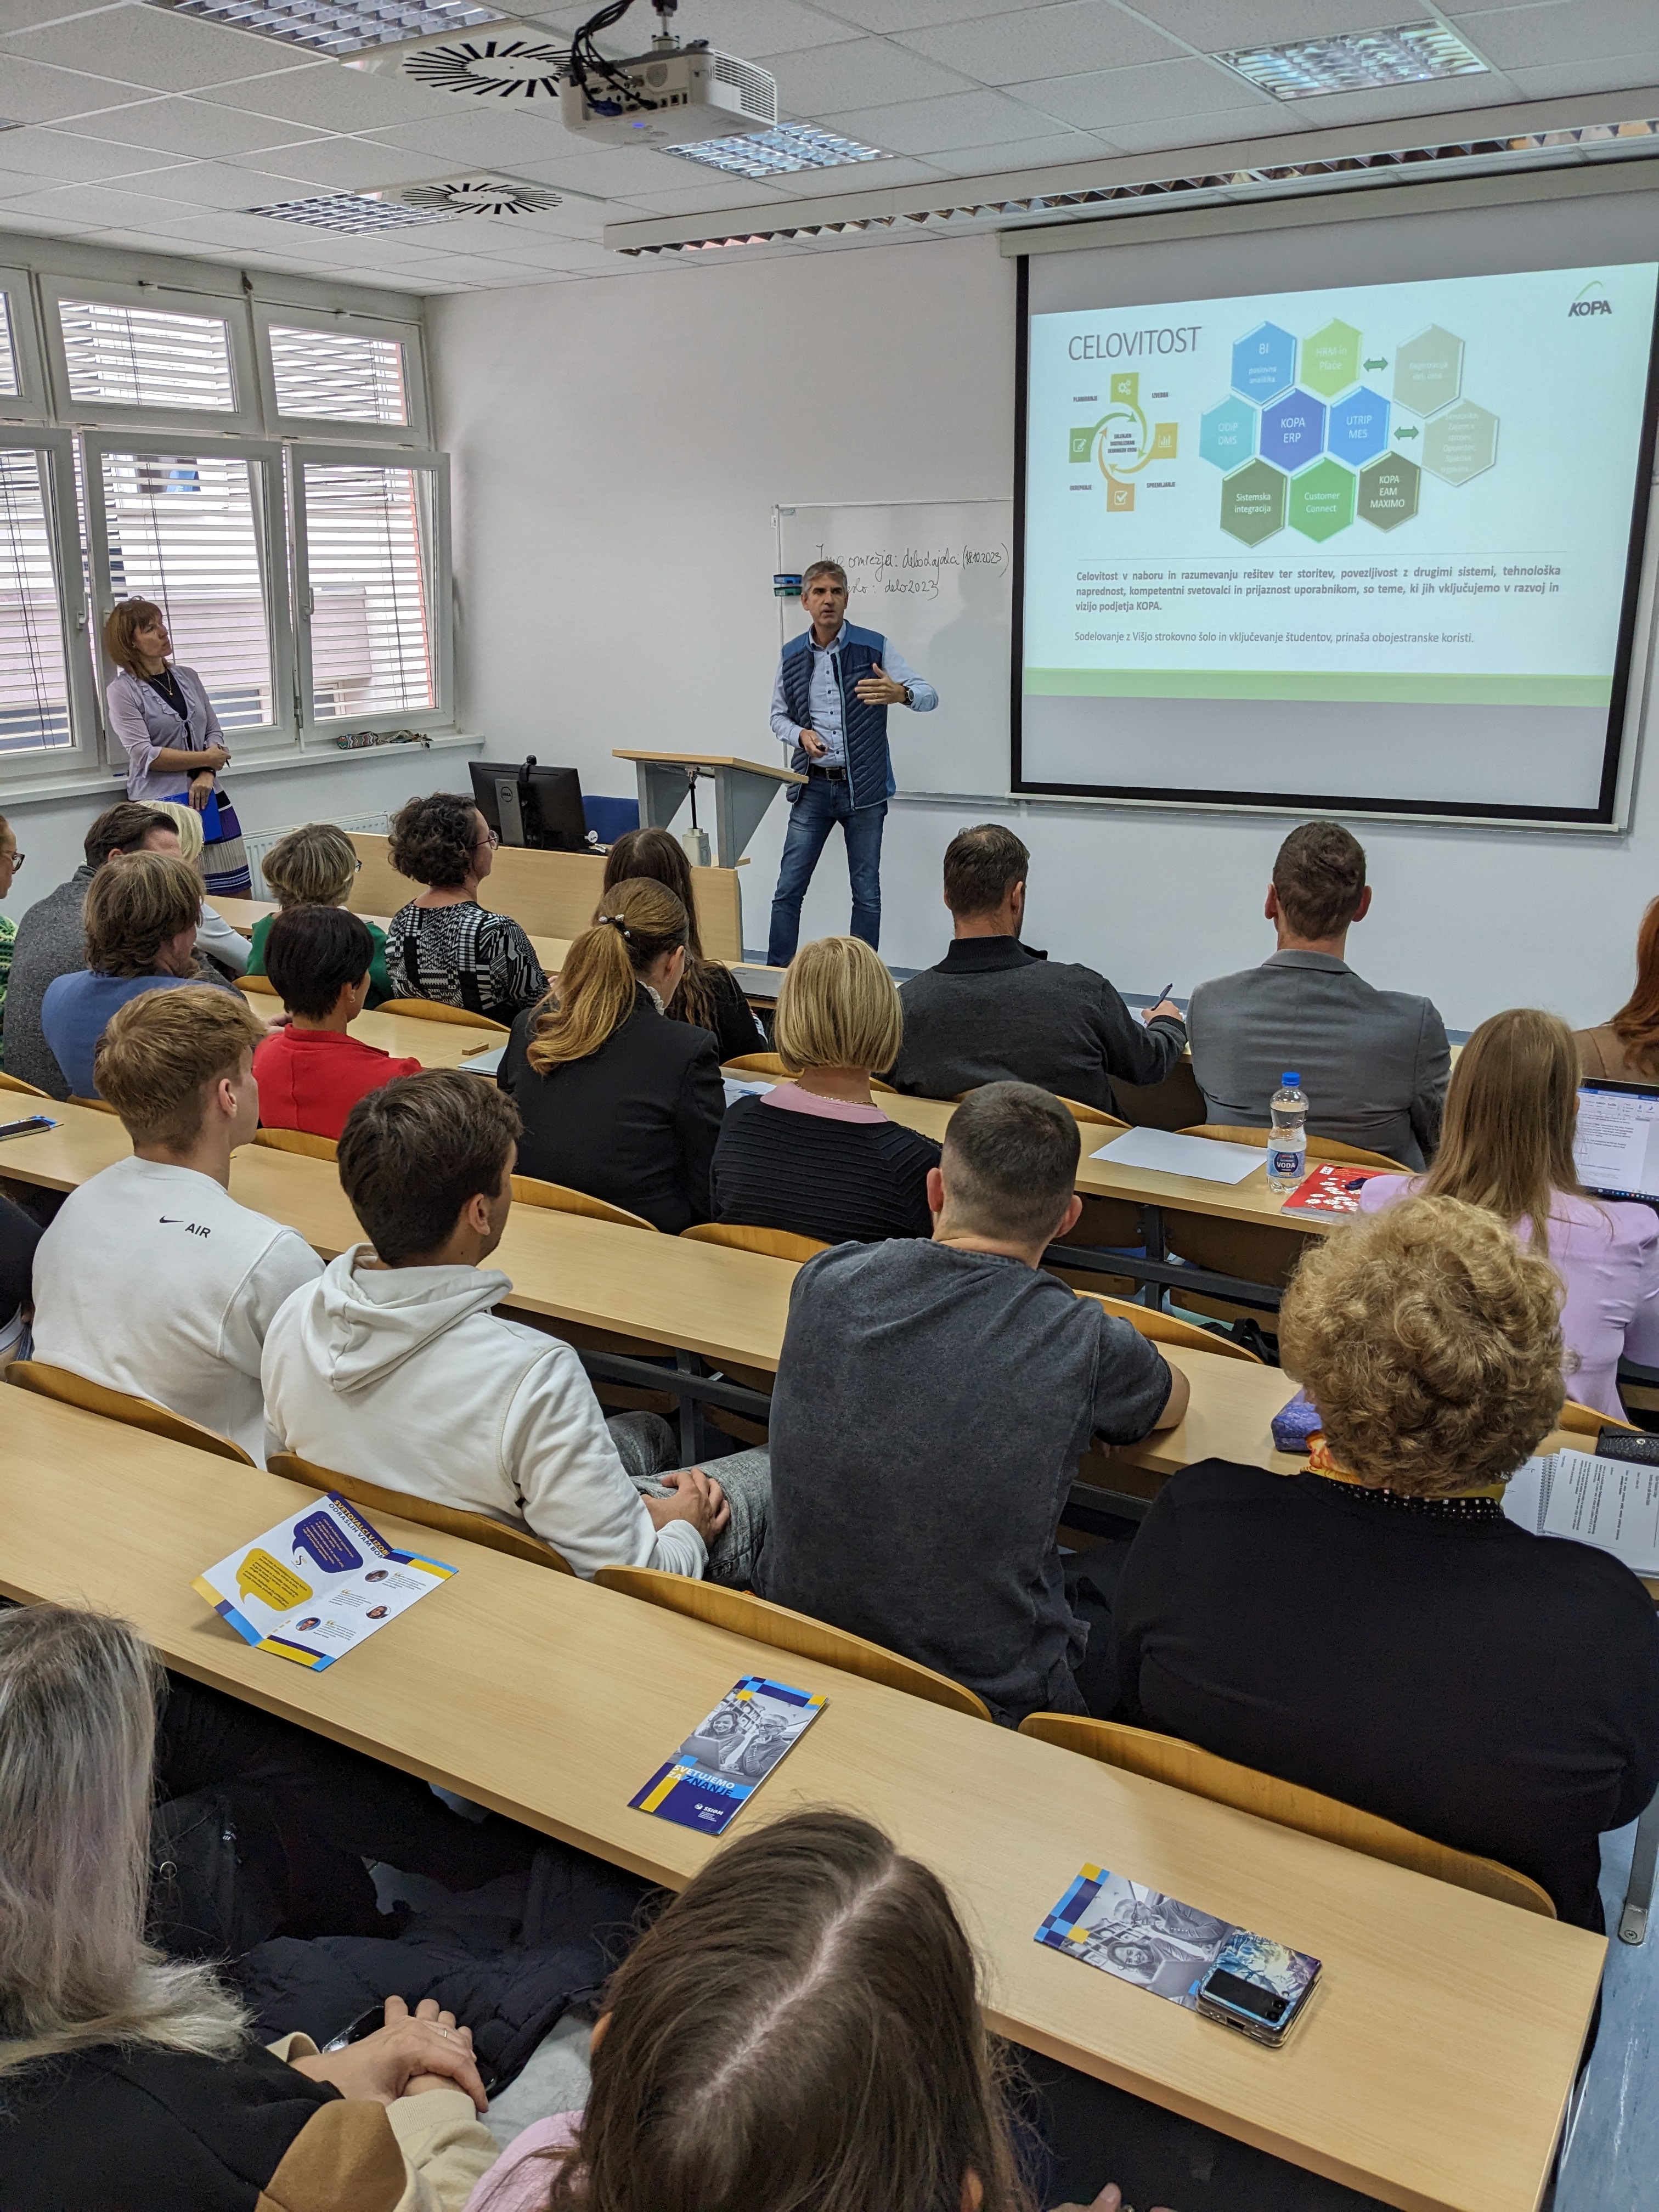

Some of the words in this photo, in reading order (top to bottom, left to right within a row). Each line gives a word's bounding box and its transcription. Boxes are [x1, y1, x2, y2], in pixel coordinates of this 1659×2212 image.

[1568, 300, 1612, 318] KOPA
[1068, 326, 1201, 361] CELOVITOST
[1259, 343, 1269, 355] BI
[1316, 347, 1337, 358] HRM
[1339, 347, 1347, 356] in
[1280, 417, 1306, 428] KOPA
[1346, 415, 1372, 426] UTRIP
[1283, 432, 1302, 443] ERP
[1348, 428, 1368, 439] MES
[1217, 436, 1238, 445] DMS
[1379, 475, 1400, 484] KOPA
[1305, 492, 1340, 501] Customer
[1379, 487, 1397, 496] EAM
[1235, 493, 1271, 502] Sistemska
[1234, 504, 1272, 515] integracija
[1306, 504, 1338, 514] Connect
[1370, 499, 1405, 509] MAXIMO
[962, 543, 1009, 577] (18.10.2023)
[1076, 571, 1118, 581] Celovitost
[1133, 571, 1163, 580] naboru
[1168, 570, 1176, 579] in
[1181, 569, 1238, 582] razumevanju
[1244, 568, 1274, 579] rešitev
[1279, 569, 1293, 579] ter
[1297, 568, 1336, 579] storitev,
[1341, 567, 1397, 579] povezljivost
[1414, 566, 1452, 578] drugimi
[1458, 566, 1496, 577] sistemi,
[1503, 565, 1561, 575] tehnološka
[1076, 585, 1126, 596] naprednost,
[1130, 585, 1184, 596] kompetentni
[1187, 585, 1231, 595] svetovalci
[1234, 585, 1242, 595] in
[1246, 585, 1290, 596] prijaznost
[1294, 584, 1359, 595] uporabnikom,
[1363, 584, 1374, 593] so
[1378, 584, 1406, 594] teme,
[1410, 583, 1418, 593] ki
[1421, 583, 1435, 595] jih
[1439, 582, 1500, 595] vključujemo
[1514, 582, 1545, 594] razvoj
[1549, 582, 1559, 591] in
[1075, 601, 1097, 612] vizijo
[1099, 601, 1133, 612] podjetja
[1136, 601, 1162, 611] KOPA.
[1075, 631, 1124, 642] Sodelovanje
[1133, 630, 1152, 642] Višjo
[1155, 631, 1196, 641] strokovno
[1199, 631, 1216, 641] šolo
[1218, 631, 1226, 641] in
[1229, 631, 1283, 643] vključevanje
[1285, 631, 1333, 643] študentov,
[1336, 632, 1369, 644] prinaša
[1372, 633, 1438, 644] obojestranske
[1442, 633, 1474, 643] koristi.
[184, 1223, 211, 1238] AIR
[329, 1503, 358, 1533] ODRASLIH
[357, 1532, 371, 1547] VAM
[334, 1499, 369, 1535] SVETOVALCI
[373, 1539, 390, 1556] IZOB
[673, 1765, 735, 1788] SVETUJEMO
[667, 1772, 681, 1780] ZA
[682, 1775, 733, 1796] ZNANJE
